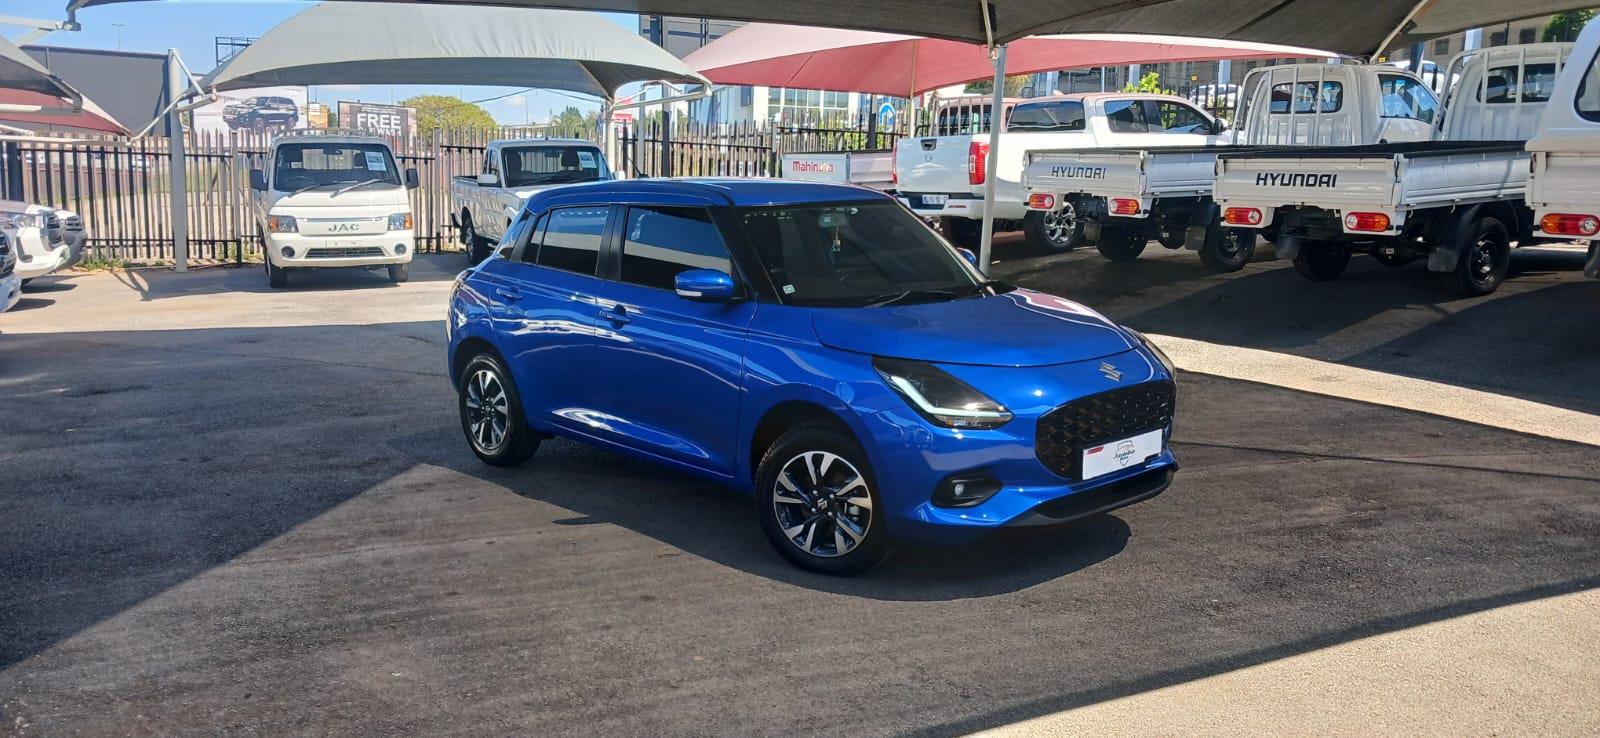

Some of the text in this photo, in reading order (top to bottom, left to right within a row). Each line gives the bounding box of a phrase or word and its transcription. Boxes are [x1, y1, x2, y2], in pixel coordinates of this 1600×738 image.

[356, 113, 401, 129] FREE
[1051, 165, 1107, 179] HYUNDAI
[1255, 172, 1338, 188] HYUNDAI
[327, 223, 361, 233] JAC
